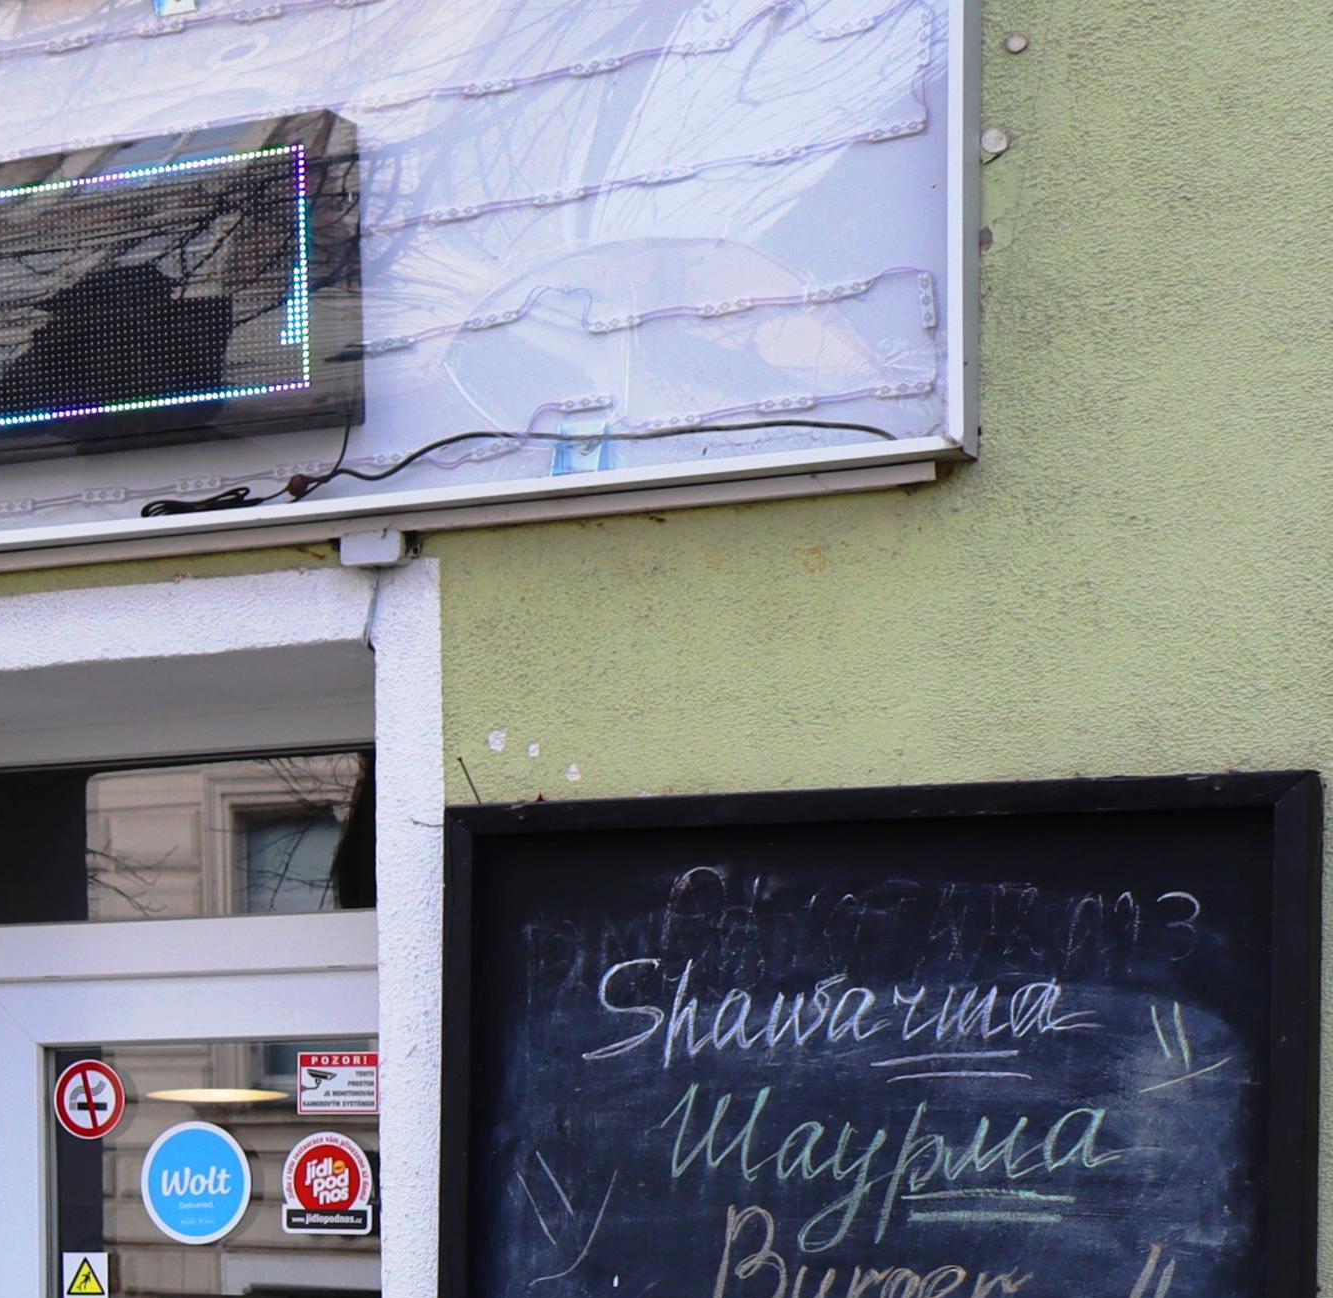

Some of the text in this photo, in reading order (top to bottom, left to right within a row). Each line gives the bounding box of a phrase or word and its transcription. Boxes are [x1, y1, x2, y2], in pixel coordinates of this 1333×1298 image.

[161, 1165, 231, 1197] Wolt
[313, 1168, 350, 1198] pod
[653, 1082, 1133, 1253] Шаурма
[319, 1187, 350, 1206] nos
